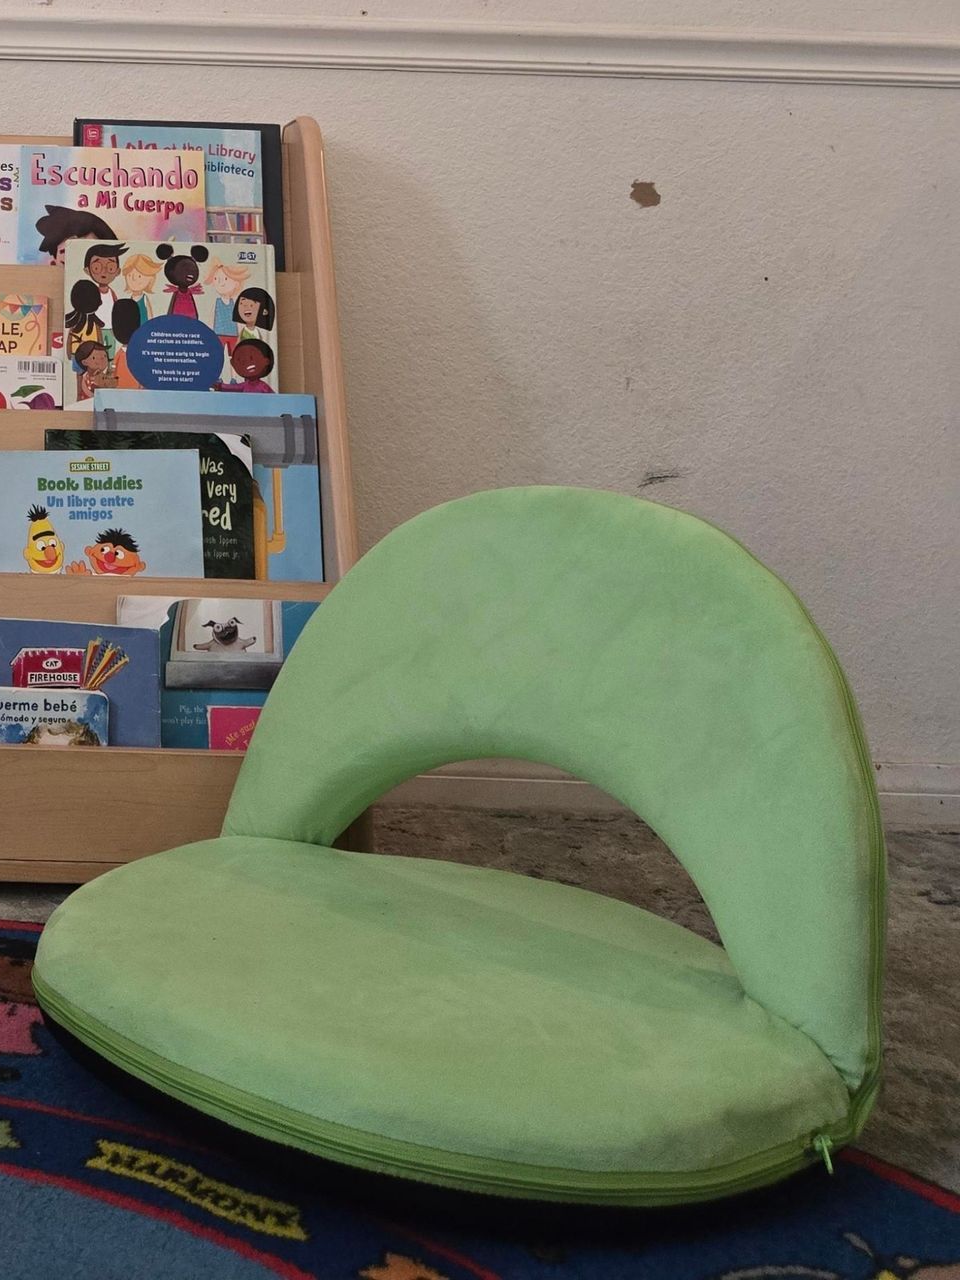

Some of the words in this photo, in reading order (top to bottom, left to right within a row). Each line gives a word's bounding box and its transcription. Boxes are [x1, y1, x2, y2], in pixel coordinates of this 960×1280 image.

[208, 143, 257, 165] Library
[30, 152, 199, 191] Escuchando
[77, 193, 89, 208] a
[95, 191, 117, 209] Mi
[123, 193, 185, 220] Cuerpo
[70, 463, 90, 471] SESAME
[90, 463, 109, 471] STREET
[37, 477, 80, 492] Book
[83, 474, 143, 491] Buddies
[206, 480, 237, 504] Very
[46, 495, 64, 508] Un
[67, 494, 97, 508] libro
[100, 495, 135, 507] entre
[68, 507, 114, 522] amigos
[29, 673, 78, 682] FIREHOUSE
[43, 698, 78, 713] bebé
[31, 716, 37, 724] y
[38, 716, 67, 725] seguro
[107, 1150, 297, 1227] HARMONY
